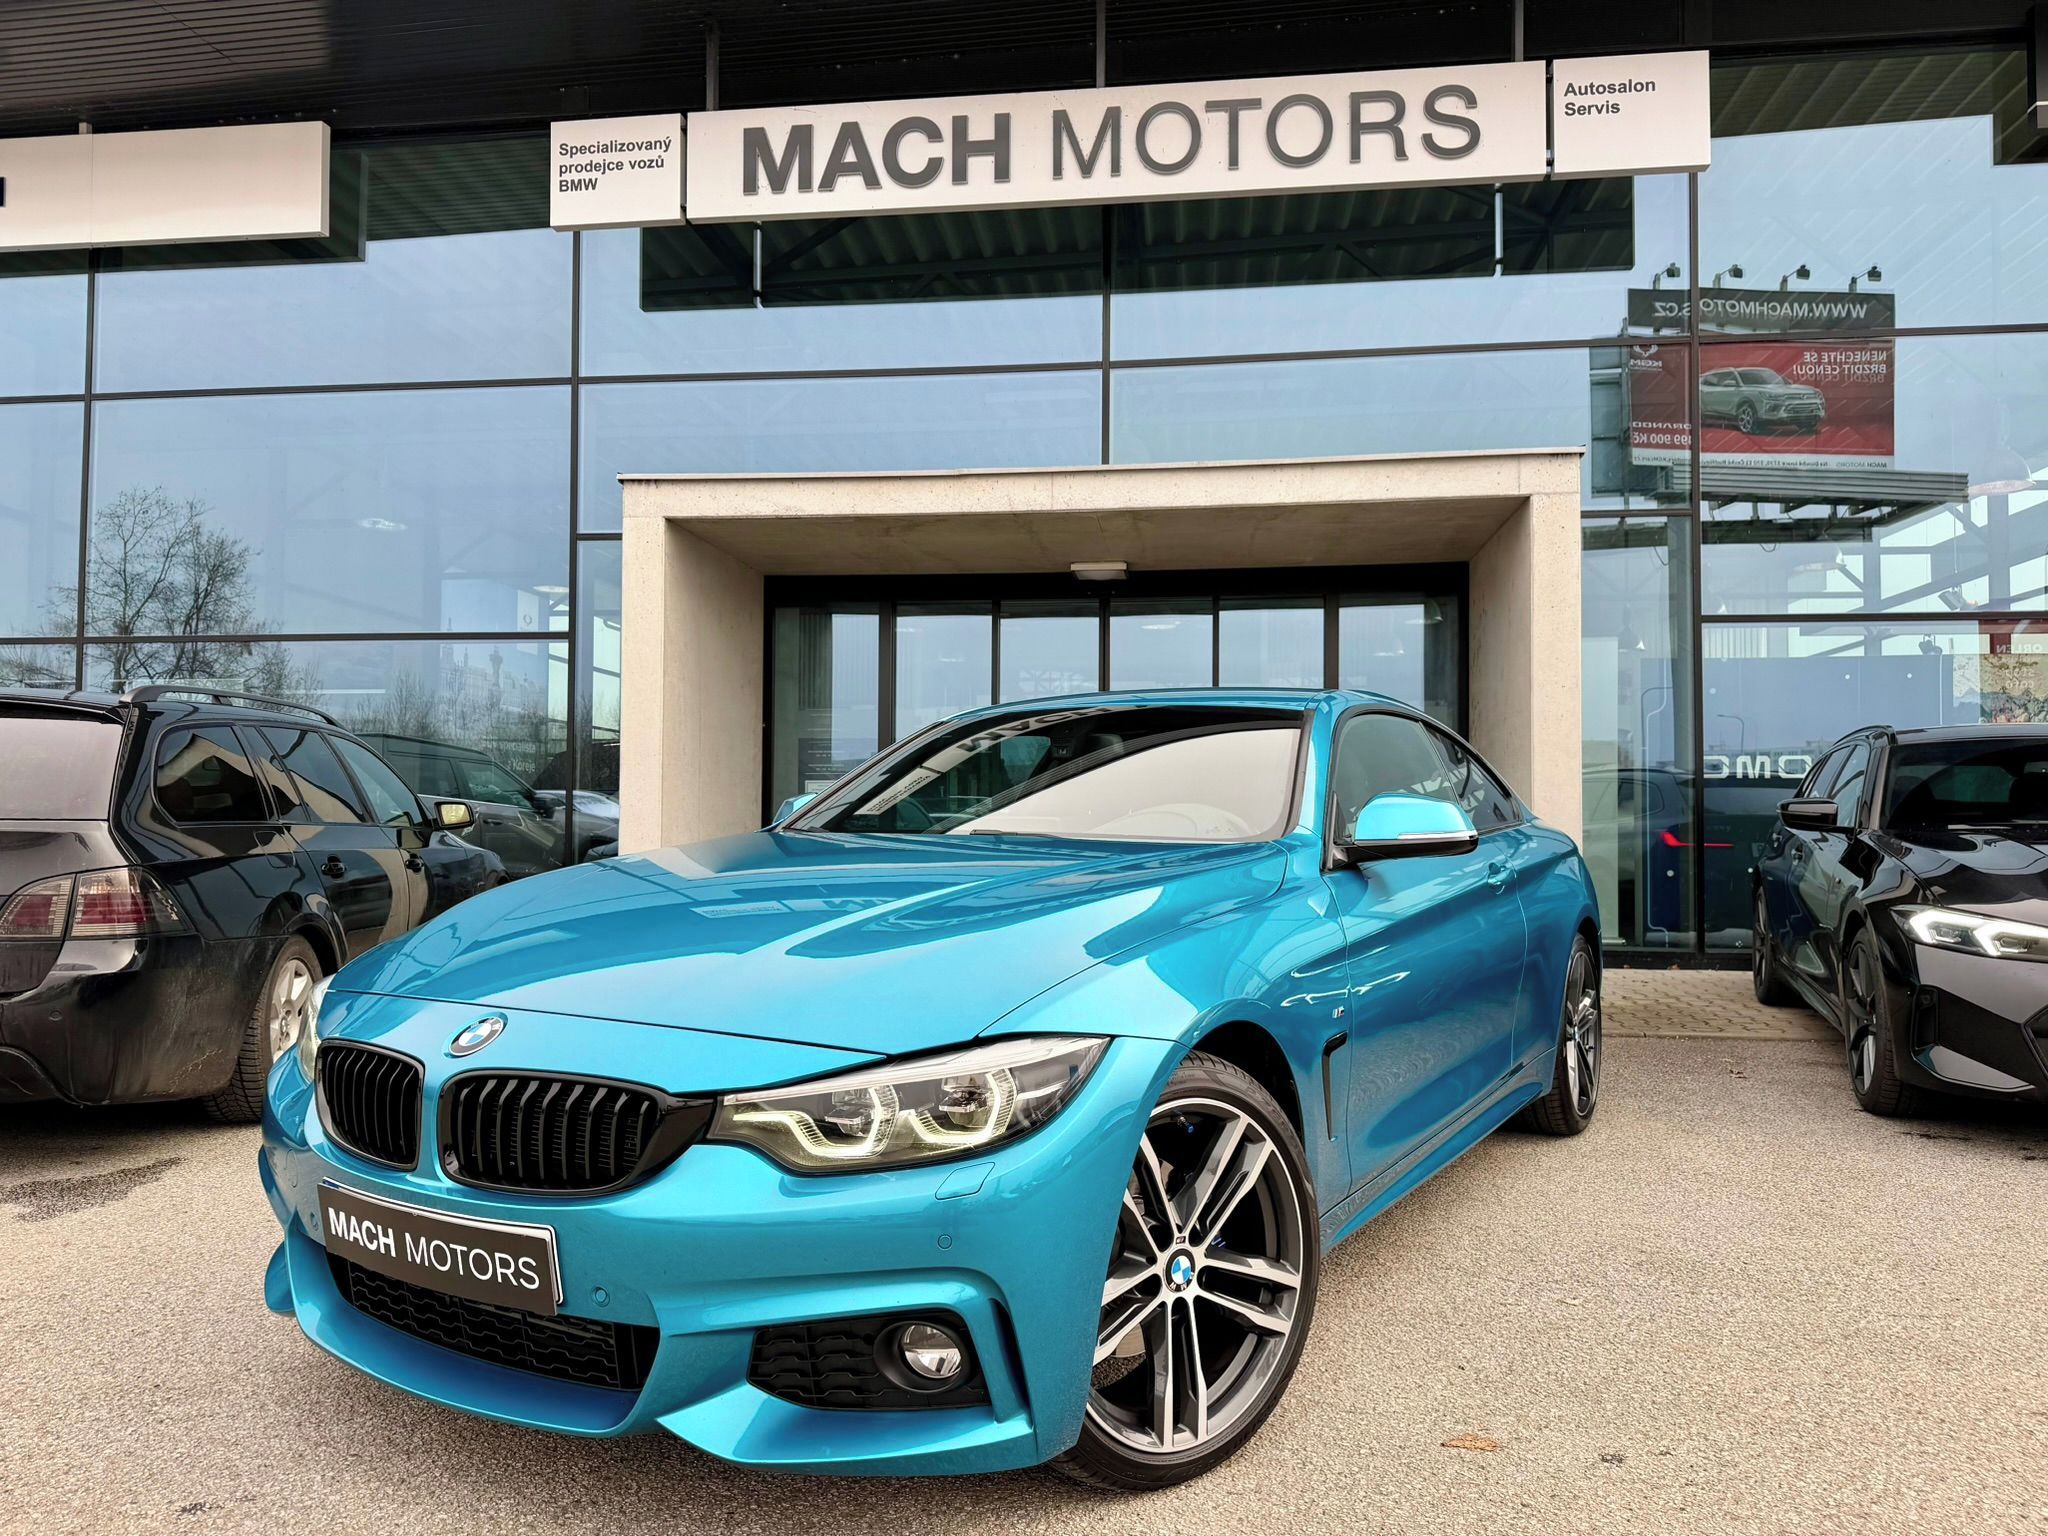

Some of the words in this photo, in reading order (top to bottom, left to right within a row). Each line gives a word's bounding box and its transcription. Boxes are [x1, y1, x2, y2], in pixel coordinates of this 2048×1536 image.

[1564, 79, 1656, 97] Autosalon
[1564, 100, 1621, 116] Servis
[559, 136, 672, 158] Specializovaný
[743, 112, 1011, 196] MACH
[1052, 84, 1482, 180] MOTORS
[559, 159, 624, 177] prodejce
[629, 154, 664, 170] vozů
[559, 178, 598, 192] BMW
[327, 1207, 397, 1257] MACH
[404, 1232, 540, 1290] MOTORS
